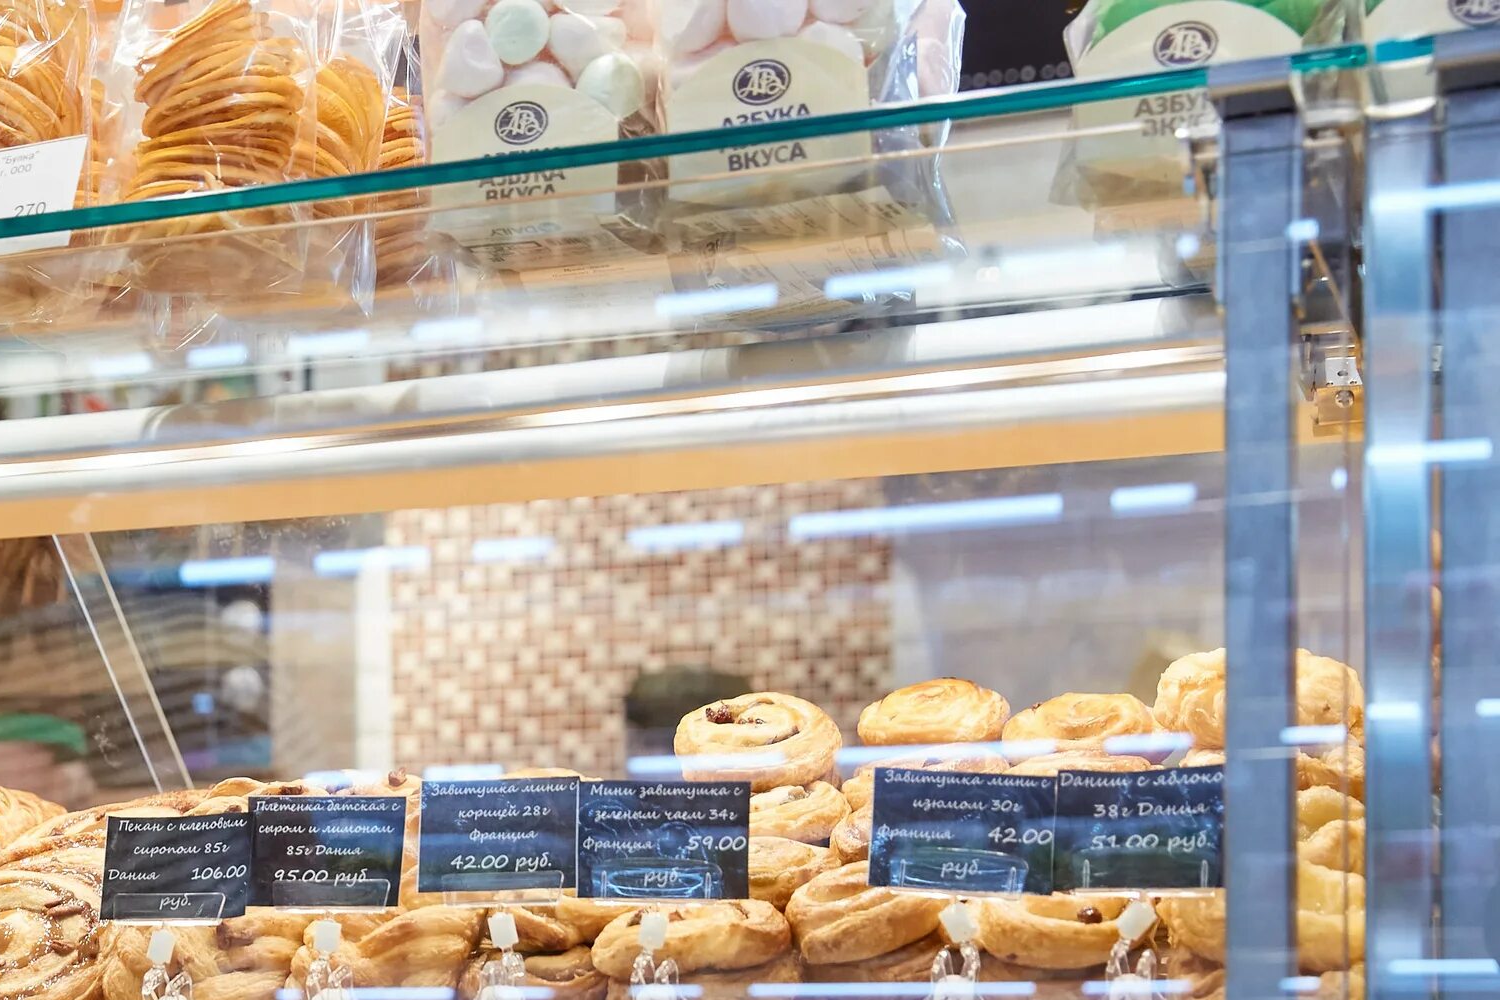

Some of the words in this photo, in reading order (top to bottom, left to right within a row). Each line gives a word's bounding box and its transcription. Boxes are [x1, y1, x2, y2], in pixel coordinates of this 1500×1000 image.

[728, 142, 807, 172] ВКУСА
[14, 201, 47, 217] 270
[884, 769, 985, 789] Завитушка
[987, 777, 1038, 788] мини
[1059, 772, 1132, 788] Даниш
[1137, 776, 1149, 787] с
[431, 782, 519, 800] Завитушка
[521, 782, 567, 793] мини
[591, 784, 635, 797] Мини
[640, 786, 729, 799] завитушка
[326, 800, 388, 812] датская
[458, 804, 520, 820] корицей
[523, 805, 551, 819] 28г
[1093, 803, 1133, 819] 38г
[1137, 802, 1209, 816] Дания
[664, 810, 706, 821] чаем
[709, 808, 739, 821] 34г
[118, 819, 164, 833] Пекан
[167, 823, 175, 831] с
[178, 818, 248, 832] кленовым
[259, 825, 304, 836] сыром
[308, 825, 320, 834] и
[322, 824, 395, 835] лимоном
[876, 824, 955, 841] Франция
[469, 828, 538, 842] Франция
[987, 827, 1053, 845] 42.00
[134, 843, 202, 859] сиропом
[204, 843, 230, 855] 85г
[286, 845, 314, 857] 85г
[315, 844, 363, 856] Дания
[582, 836, 653, 851] Франция
[687, 836, 747, 852] 59.00
[450, 855, 509, 871] 42.00
[515, 854, 553, 873] руб.
[940, 858, 983, 880] руб.
[108, 868, 160, 881] Дания
[191, 864, 247, 881] 106.00
[274, 869, 328, 883] 95.00
[334, 868, 372, 887] руб.
[643, 868, 683, 887] руб.
[159, 893, 192, 911] руб.
